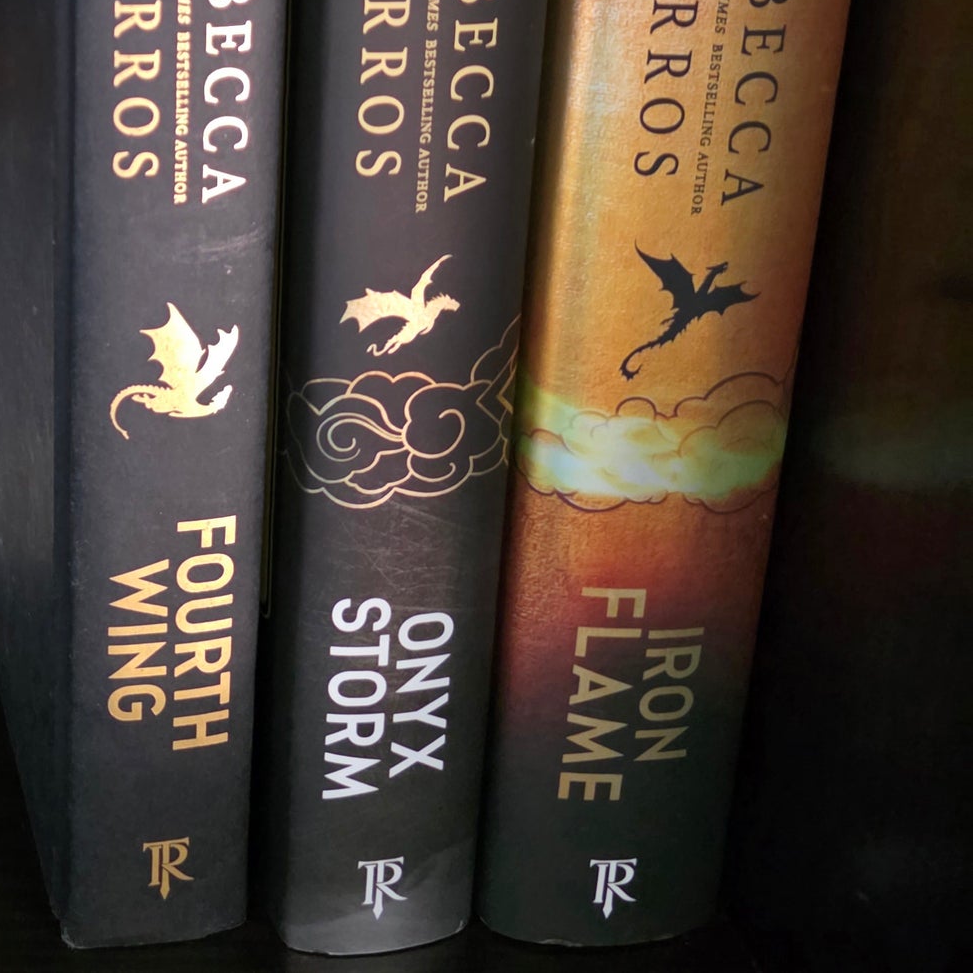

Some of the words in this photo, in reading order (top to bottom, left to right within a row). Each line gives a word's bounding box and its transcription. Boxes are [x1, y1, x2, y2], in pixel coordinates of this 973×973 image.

[175, 32, 190, 136] BESTSELLING
[419, 39, 437, 144] BESTSELLING
[700, 44, 723, 146] BESTSELLING
[174, 140, 188, 204] AUTHOR
[415, 148, 430, 213] AUTHOR
[690, 152, 709, 216] AUTHOR
[108, 558, 169, 723] WING
[171, 515, 236, 751] FOURTH
[321, 597, 391, 801] STORM
[388, 611, 455, 778] ONYX
[557, 586, 648, 802] FLAME
[634, 626, 705, 763] IRON
